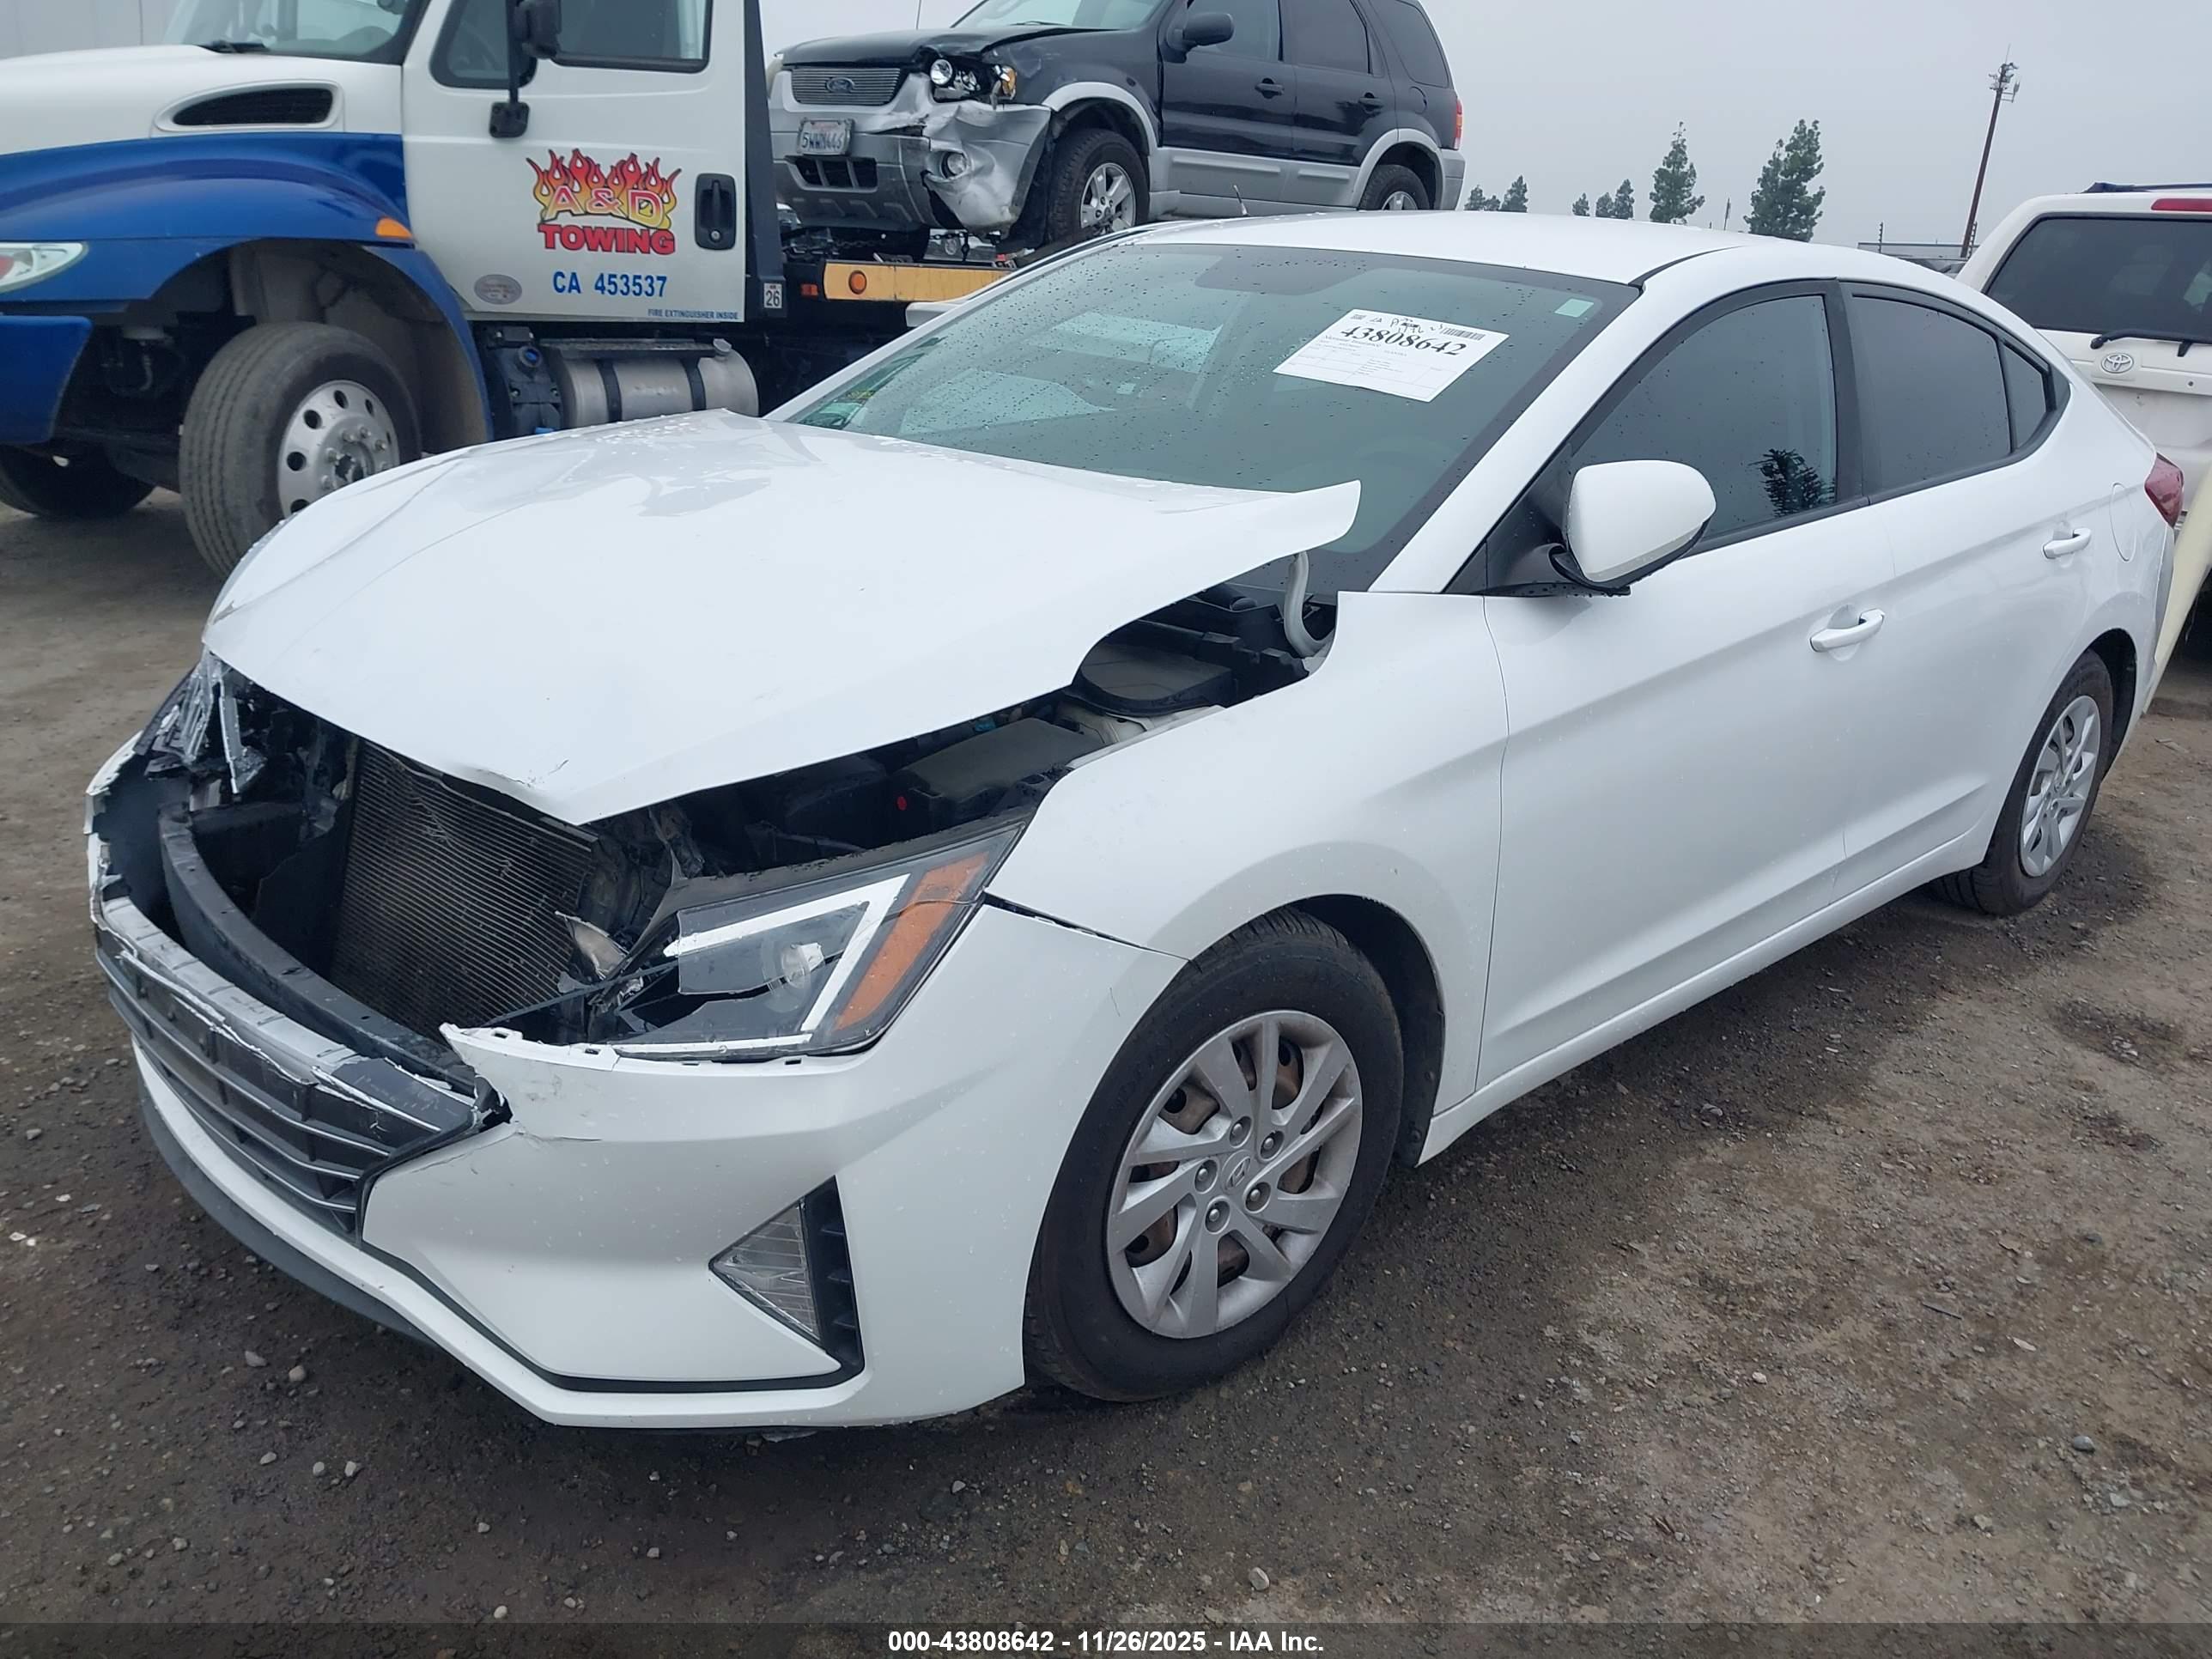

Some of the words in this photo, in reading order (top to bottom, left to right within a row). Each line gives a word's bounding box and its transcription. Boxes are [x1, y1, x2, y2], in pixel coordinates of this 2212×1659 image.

[543, 183, 665, 228] A&D
[538, 222, 676, 255] TOWING
[552, 270, 582, 295] CA
[594, 272, 667, 297] 453537
[765, 289, 781, 307] 26
[647, 309, 663, 318] FIRE
[665, 309, 714, 319] EXTINGUISHER
[715, 311, 739, 320] INSIDE
[1340, 325, 1468, 356] 43808642
